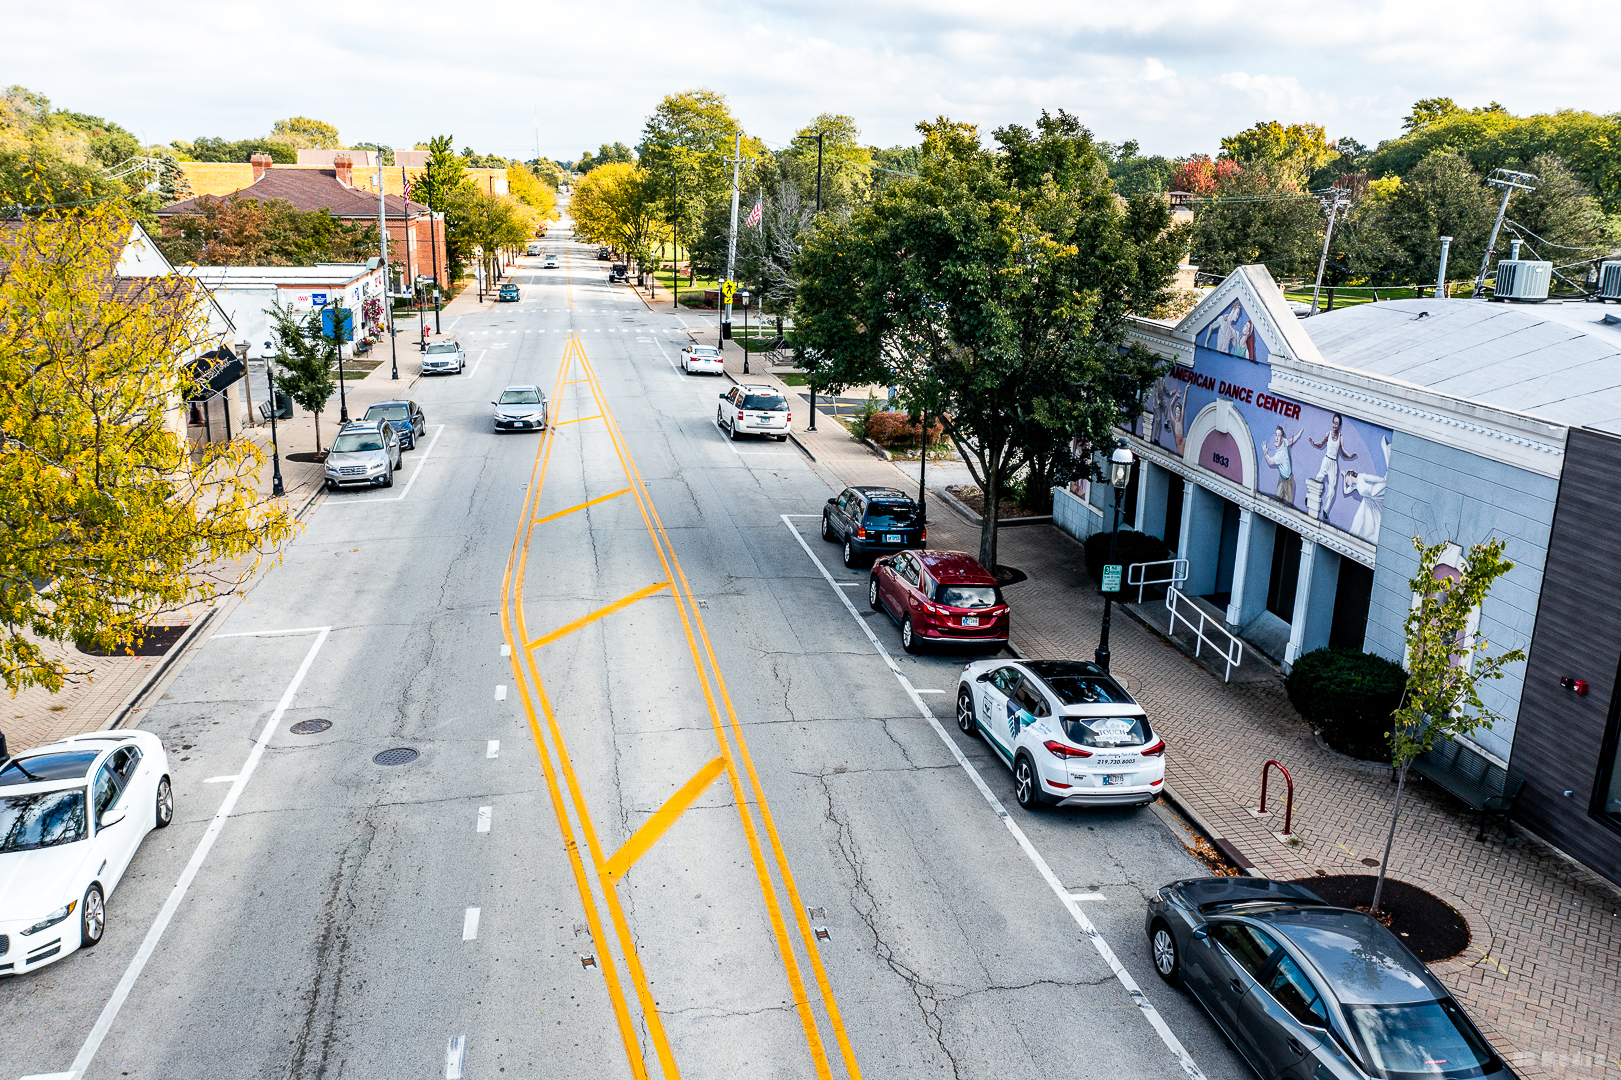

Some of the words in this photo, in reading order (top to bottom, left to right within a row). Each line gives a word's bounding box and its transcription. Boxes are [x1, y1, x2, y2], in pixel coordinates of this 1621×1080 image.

[1169, 366, 1216, 391] AMERICAN
[1218, 380, 1254, 404] DANCE
[1256, 393, 1301, 420] CENTER
[1212, 452, 1230, 468] 1933
